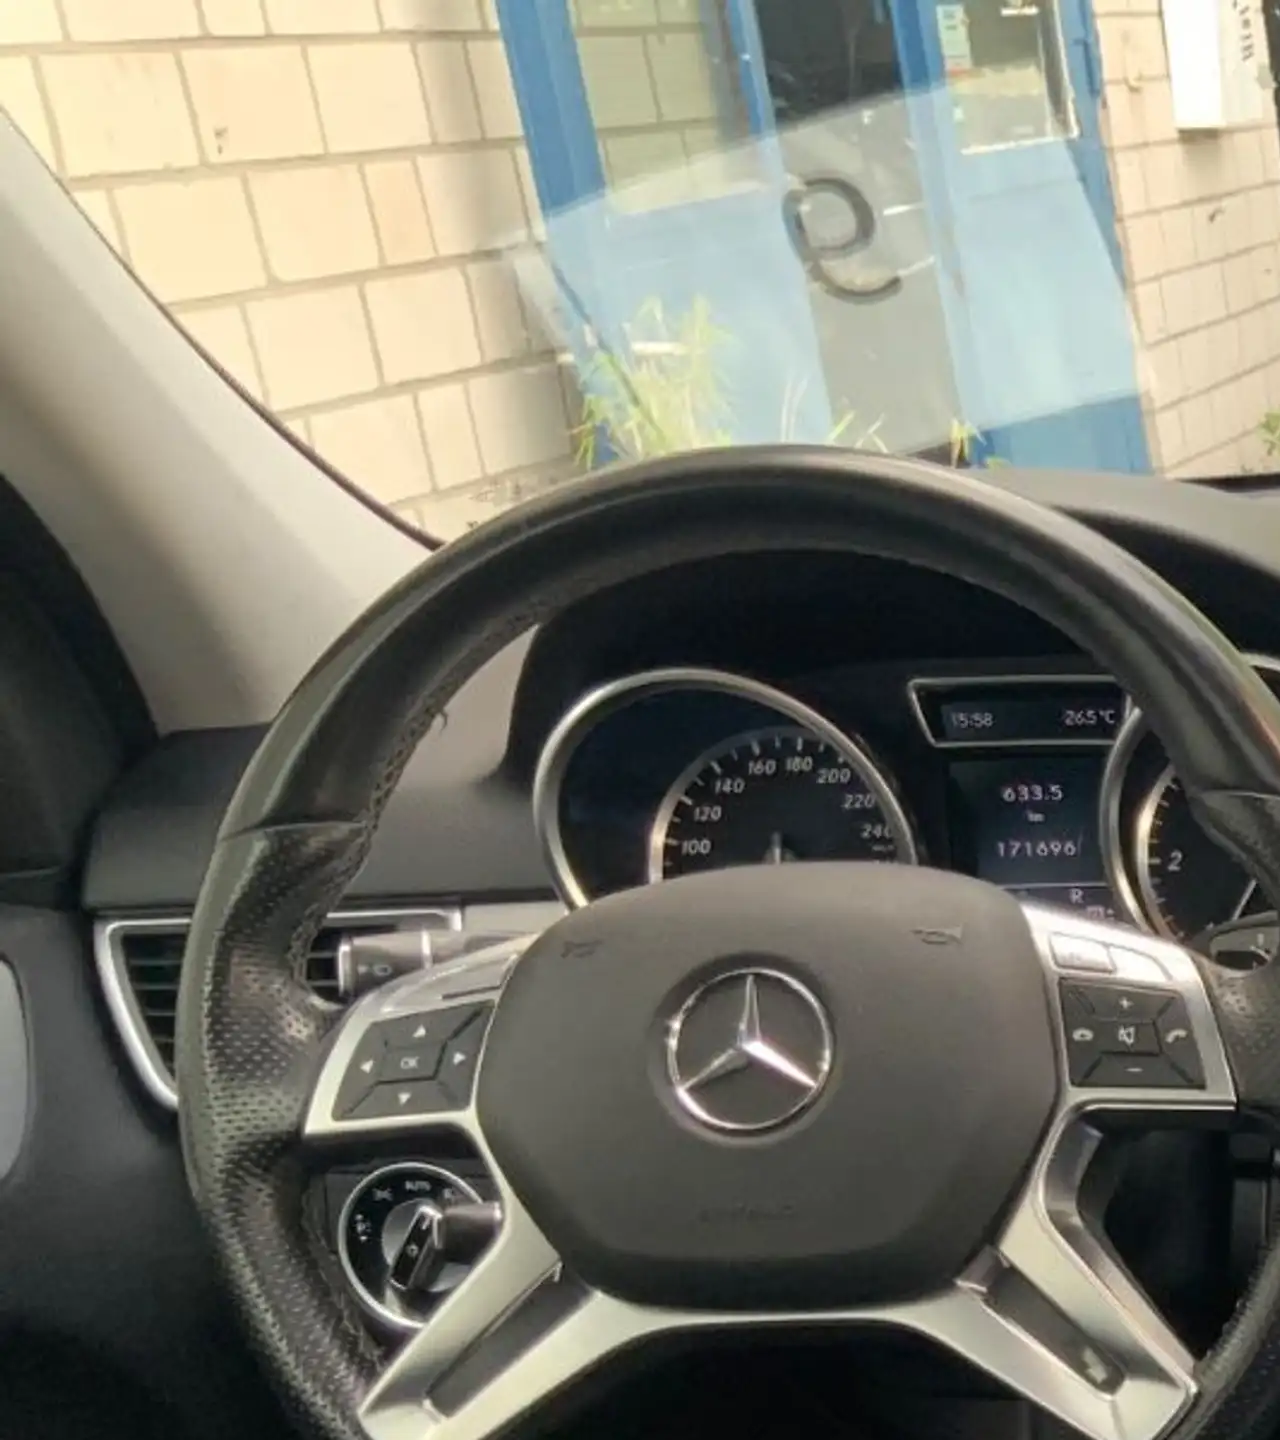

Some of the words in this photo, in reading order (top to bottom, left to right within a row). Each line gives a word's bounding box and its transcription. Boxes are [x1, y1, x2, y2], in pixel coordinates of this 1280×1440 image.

[952, 712, 994, 729] 15:58
[749, 759, 776, 775] 160
[785, 755, 813, 772] 180
[816, 767, 851, 784] 200
[715, 778, 745, 794] 140
[1002, 784, 1064, 802] 633.5
[841, 792, 875, 809] 220
[681, 838, 711, 854] 100
[997, 840, 1077, 858] 171696
[1167, 850, 1183, 871] 2
[400, 1055, 420, 1070] OK
